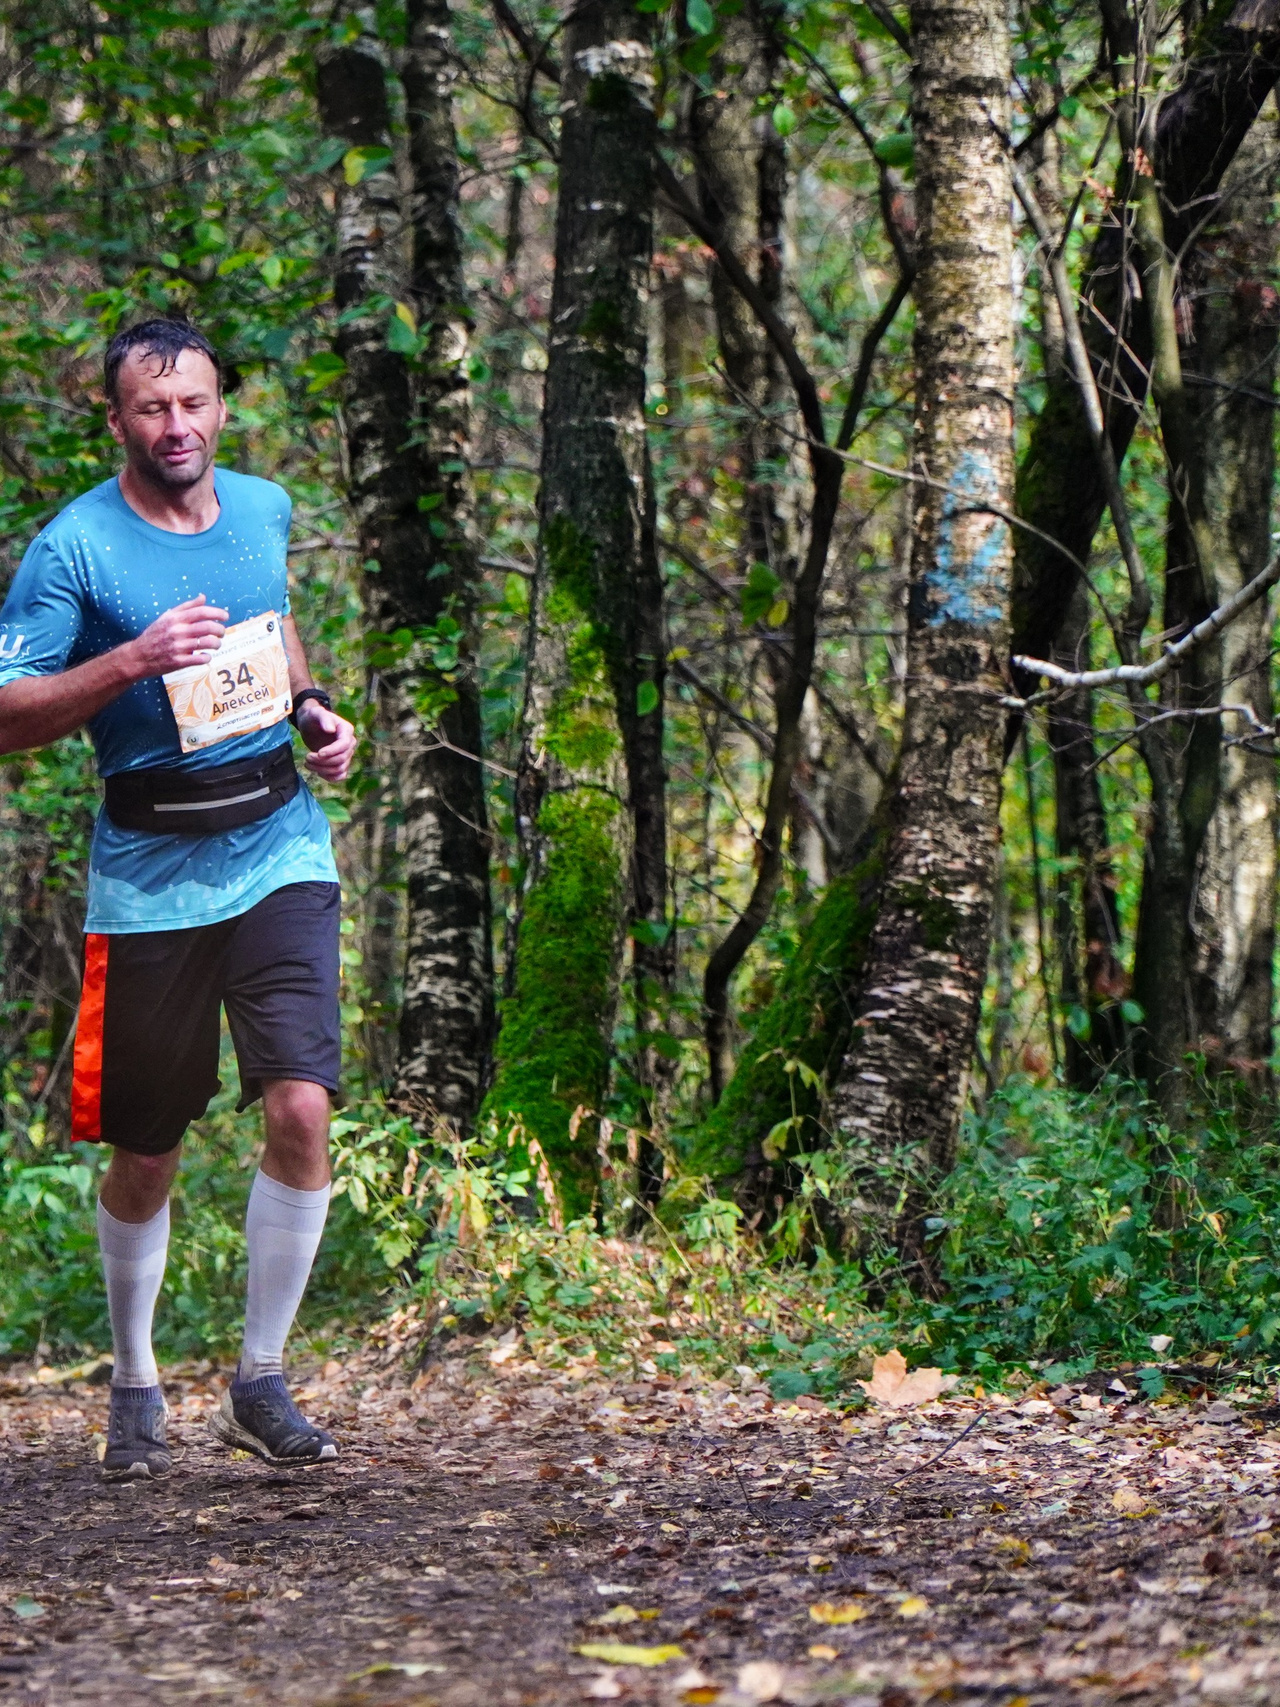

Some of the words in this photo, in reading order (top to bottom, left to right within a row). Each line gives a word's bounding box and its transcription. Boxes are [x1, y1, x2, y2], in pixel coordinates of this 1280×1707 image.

[217, 661, 254, 696] 34
[212, 684, 270, 716] Алексей
[262, 704, 275, 714] PRO
